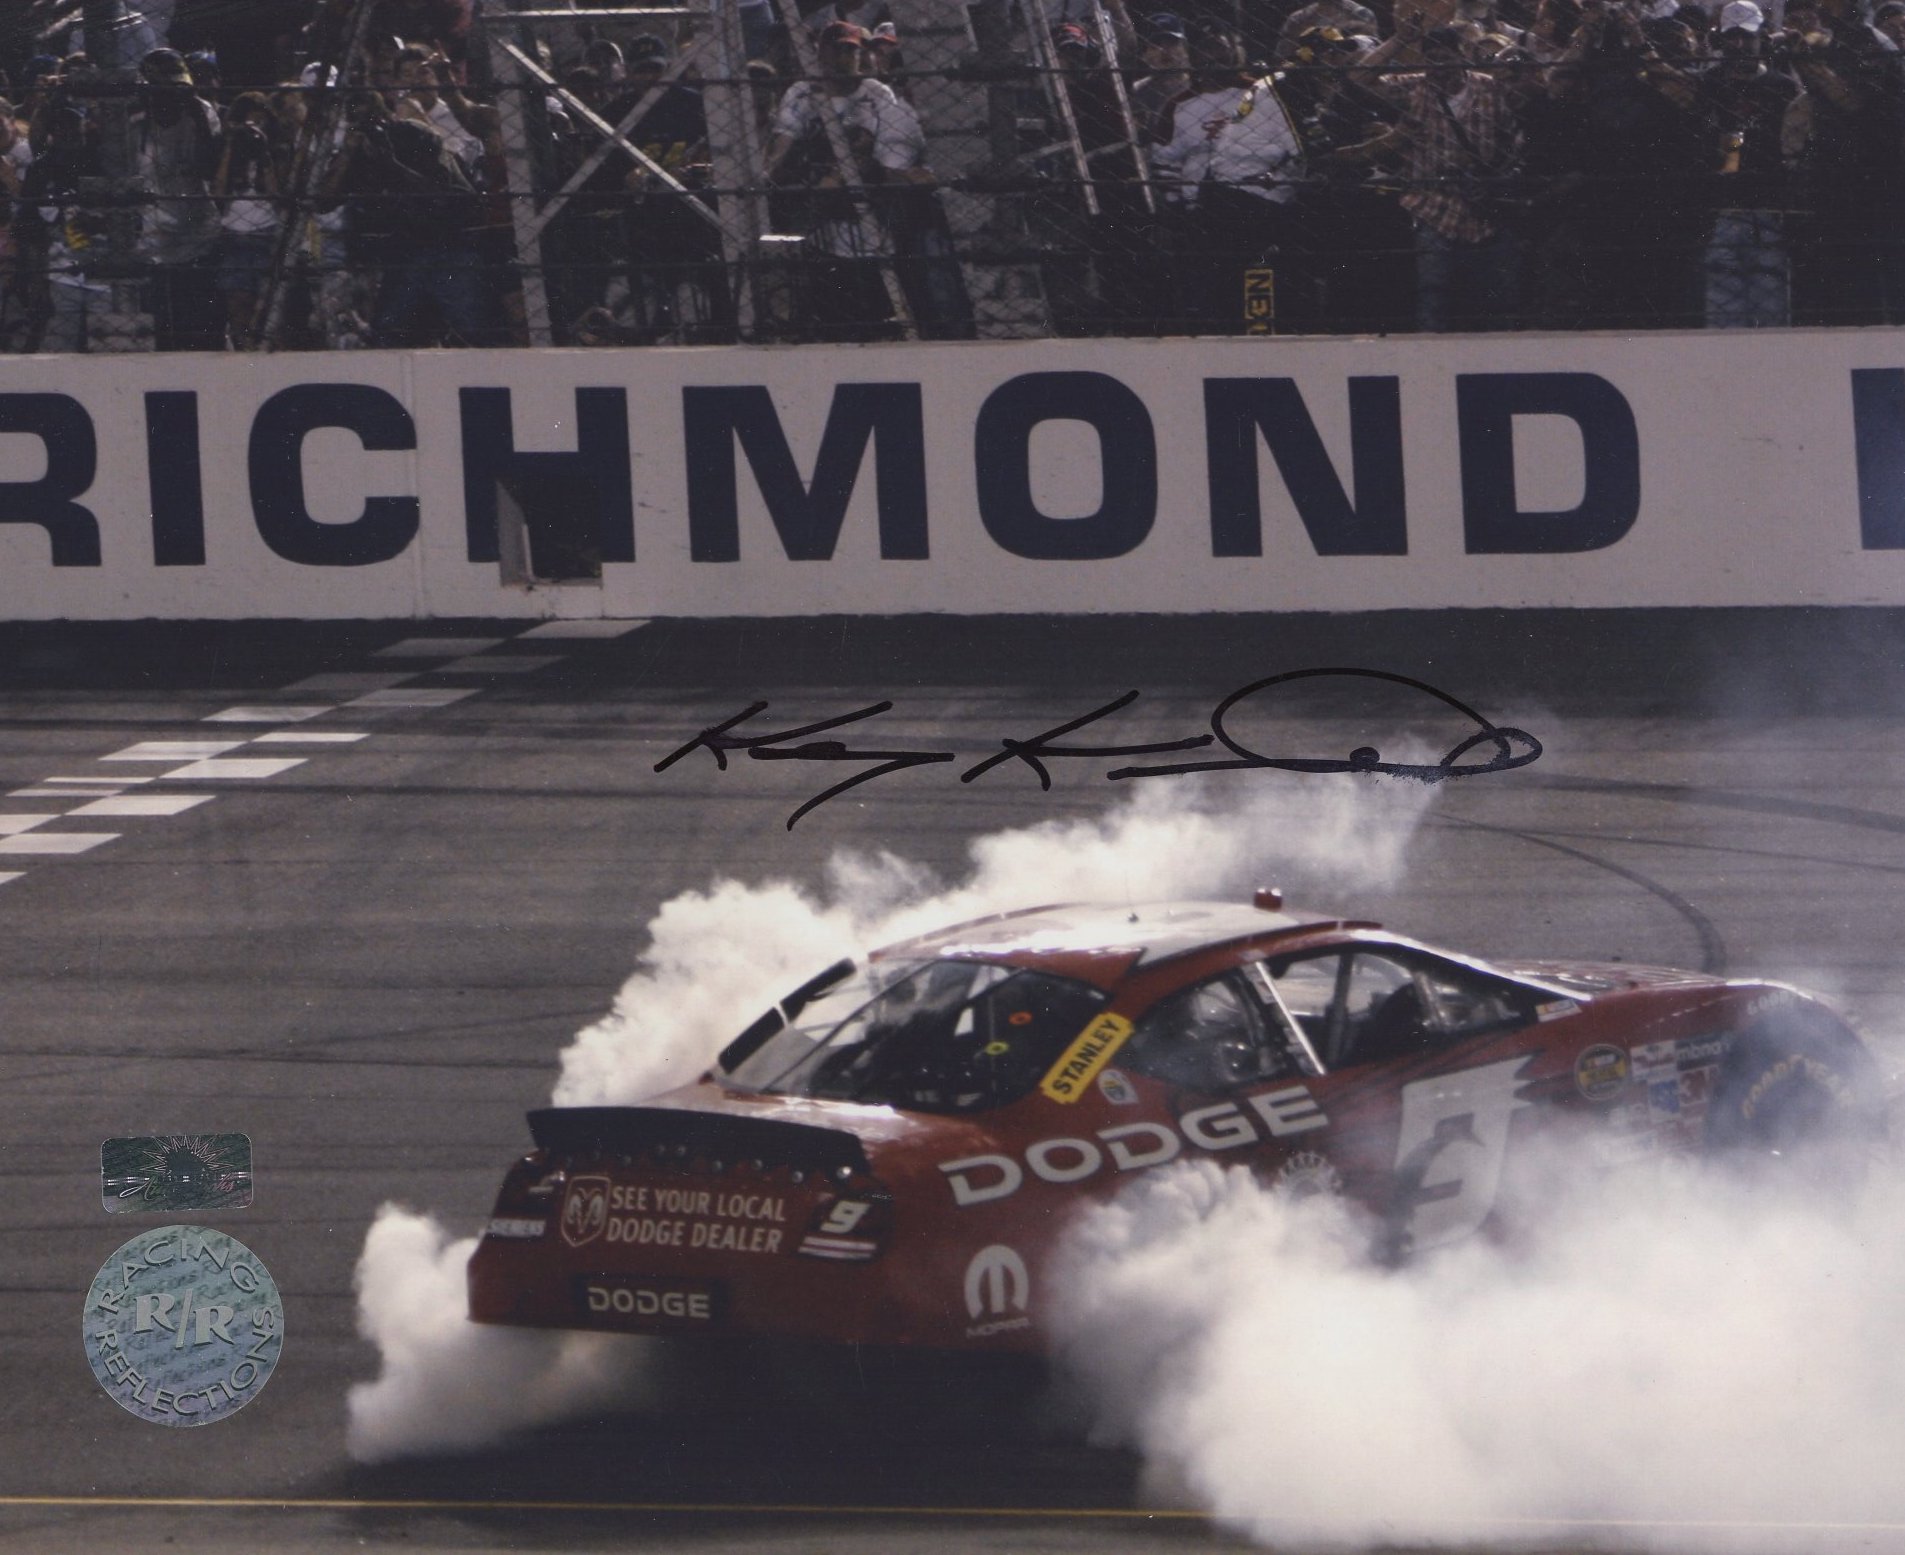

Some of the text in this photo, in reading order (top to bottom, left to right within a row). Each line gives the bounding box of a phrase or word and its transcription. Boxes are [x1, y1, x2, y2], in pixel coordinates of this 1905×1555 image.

[0, 370, 1641, 567] RICHMOND
[1051, 1018, 1122, 1096] STANLEY
[938, 1085, 1330, 1206] DODGE
[606, 1216, 784, 1254] DODGE DEALER
[610, 1184, 786, 1223] SEE YOUR LOCAL
[819, 1198, 873, 1235] 9
[97, 1237, 261, 1316] RACING
[587, 1286, 711, 1320] DODGE
[133, 1287, 236, 1351] R/R
[95, 1304, 276, 1417] REFLECTIONS
